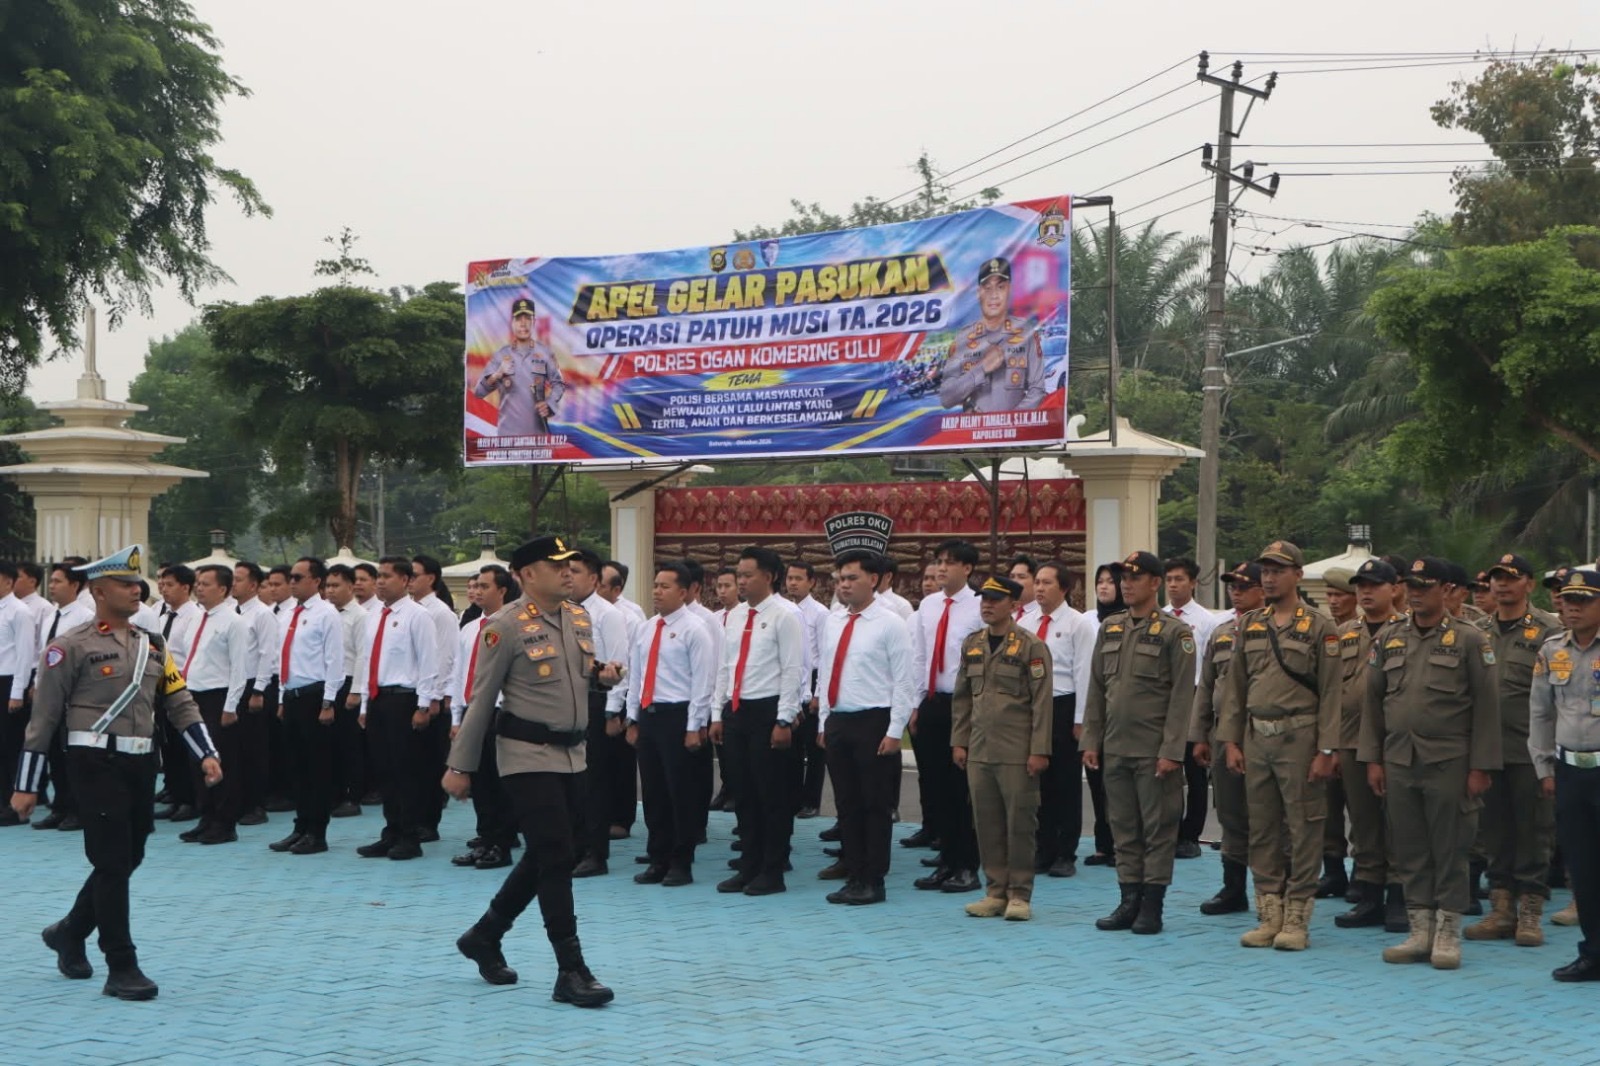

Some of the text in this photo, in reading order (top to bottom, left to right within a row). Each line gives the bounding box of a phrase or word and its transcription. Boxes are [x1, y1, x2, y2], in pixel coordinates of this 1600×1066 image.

[586, 256, 929, 321] APEL GELAR PASUKAN
[586, 298, 943, 349] OPERASI PATUH MUSI TA.2026
[634, 338, 881, 373] POLRES OGAN KOMERING ULU
[727, 371, 763, 387] TEMA
[669, 387, 826, 405] POLISI BERSAMA MASYARAKAT
[662, 399, 834, 417] MEWUJUDKAN LALU LINTAS YANG
[651, 410, 843, 430] TERTIB, AMAN DAN BERKESELAMATAN
[829, 516, 889, 532] POLRES OKU
[523, 634, 549, 645] HELMY
